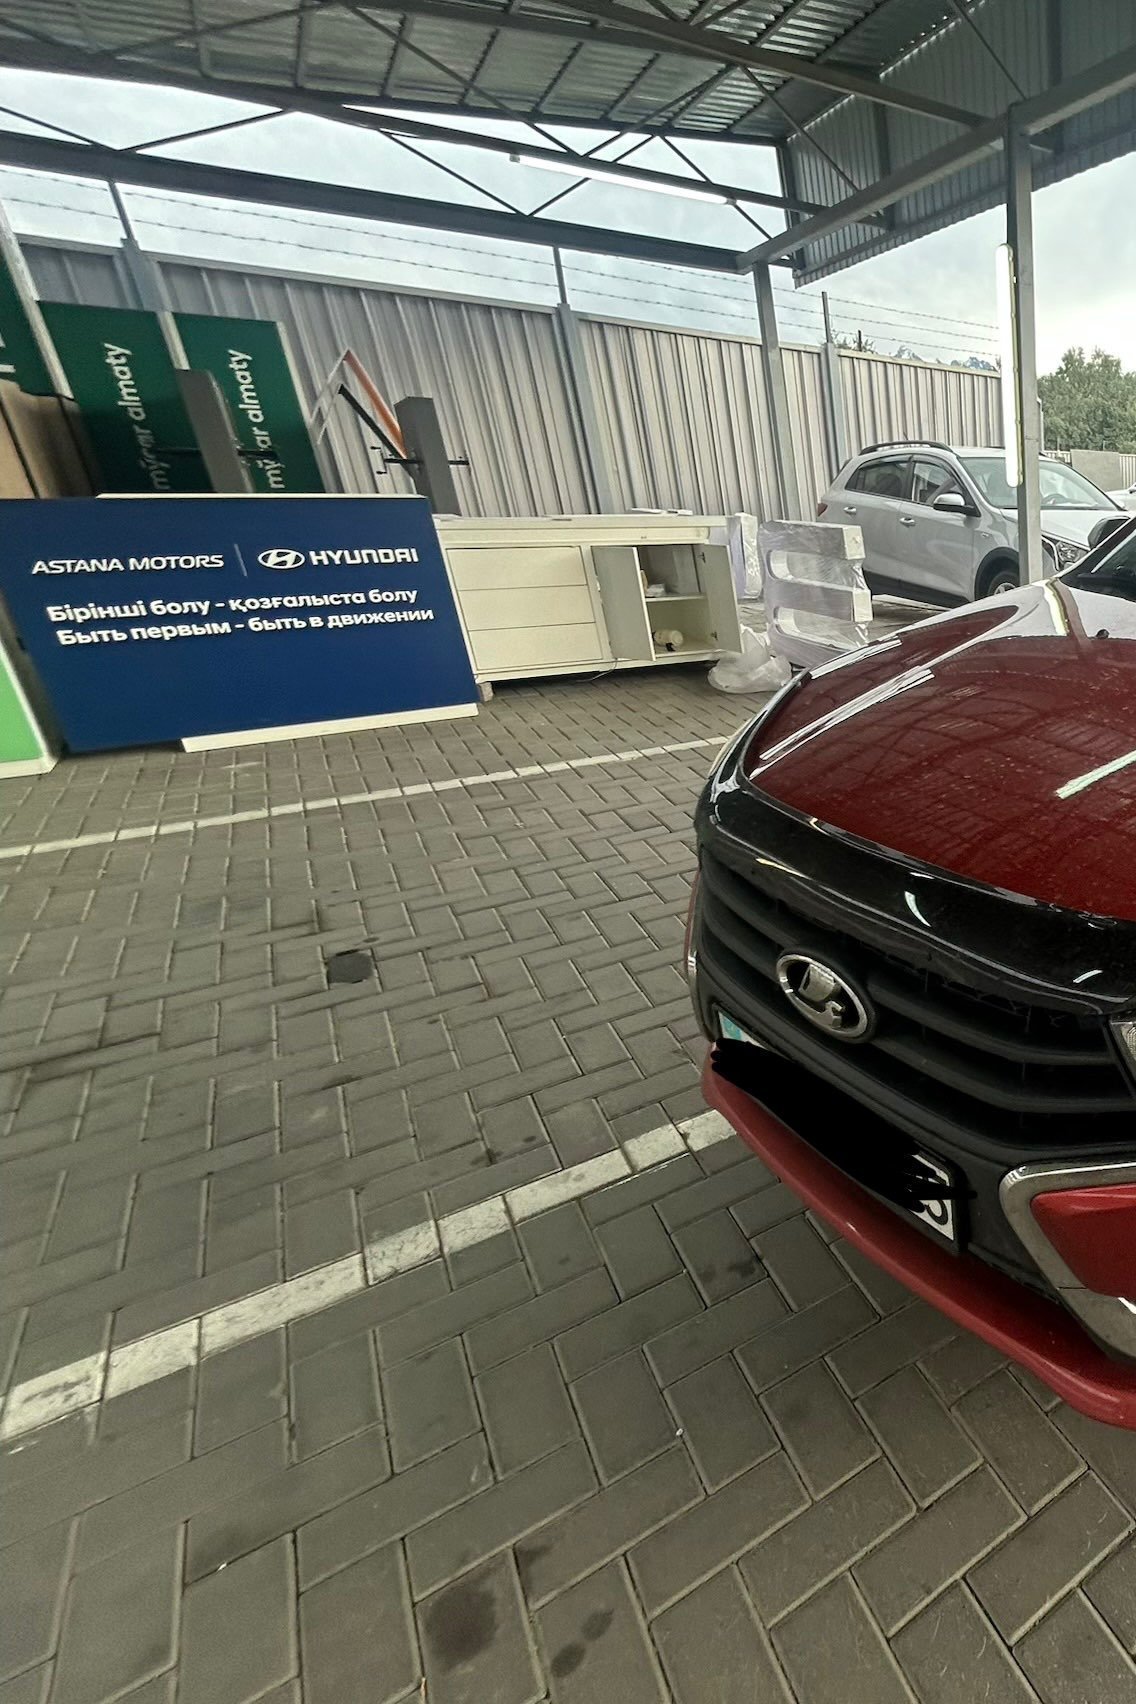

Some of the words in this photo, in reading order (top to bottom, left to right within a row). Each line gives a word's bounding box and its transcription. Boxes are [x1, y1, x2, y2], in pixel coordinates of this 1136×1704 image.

[104, 343, 146, 421] almaty
[228, 349, 264, 423] almaty
[31, 558, 124, 575] ASTANA
[129, 555, 224, 571] MOTORS
[310, 548, 419, 566] HYUNDAI
[46, 600, 148, 623] Бірінші
[150, 599, 210, 616] болу
[229, 593, 366, 613] қозғалыста
[369, 589, 418, 604] болу
[57, 627, 128, 646] Быть
[132, 621, 232, 641] первым
[248, 617, 306, 632] быть
[309, 614, 325, 628] в
[327, 609, 434, 628] движении
